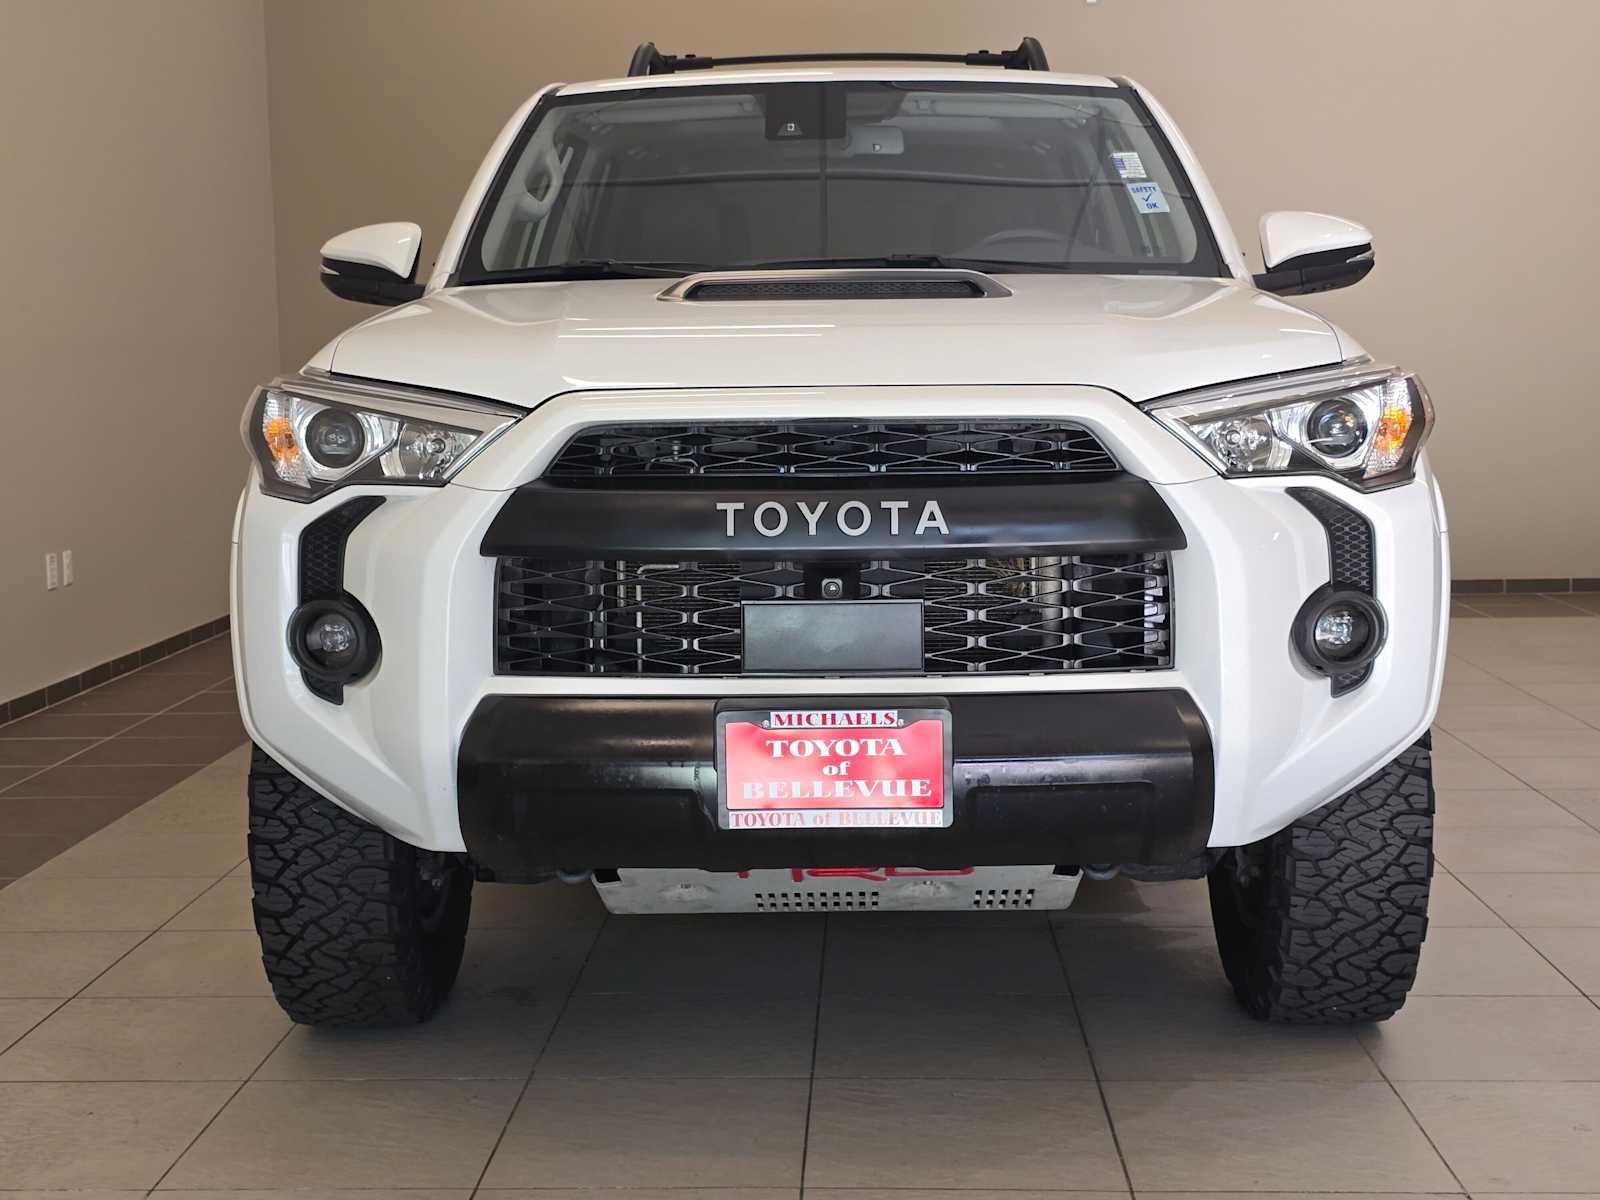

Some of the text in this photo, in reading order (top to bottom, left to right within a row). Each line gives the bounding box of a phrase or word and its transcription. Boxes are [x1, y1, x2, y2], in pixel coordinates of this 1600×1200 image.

[716, 501, 950, 537] TOYOTA
[773, 711, 897, 727] MICHAELS
[766, 738, 905, 758] TOYOTA
[823, 761, 851, 776] of
[742, 779, 933, 800] BELLEVUE
[731, 811, 943, 827] TOYOTA of BELLEVUE
